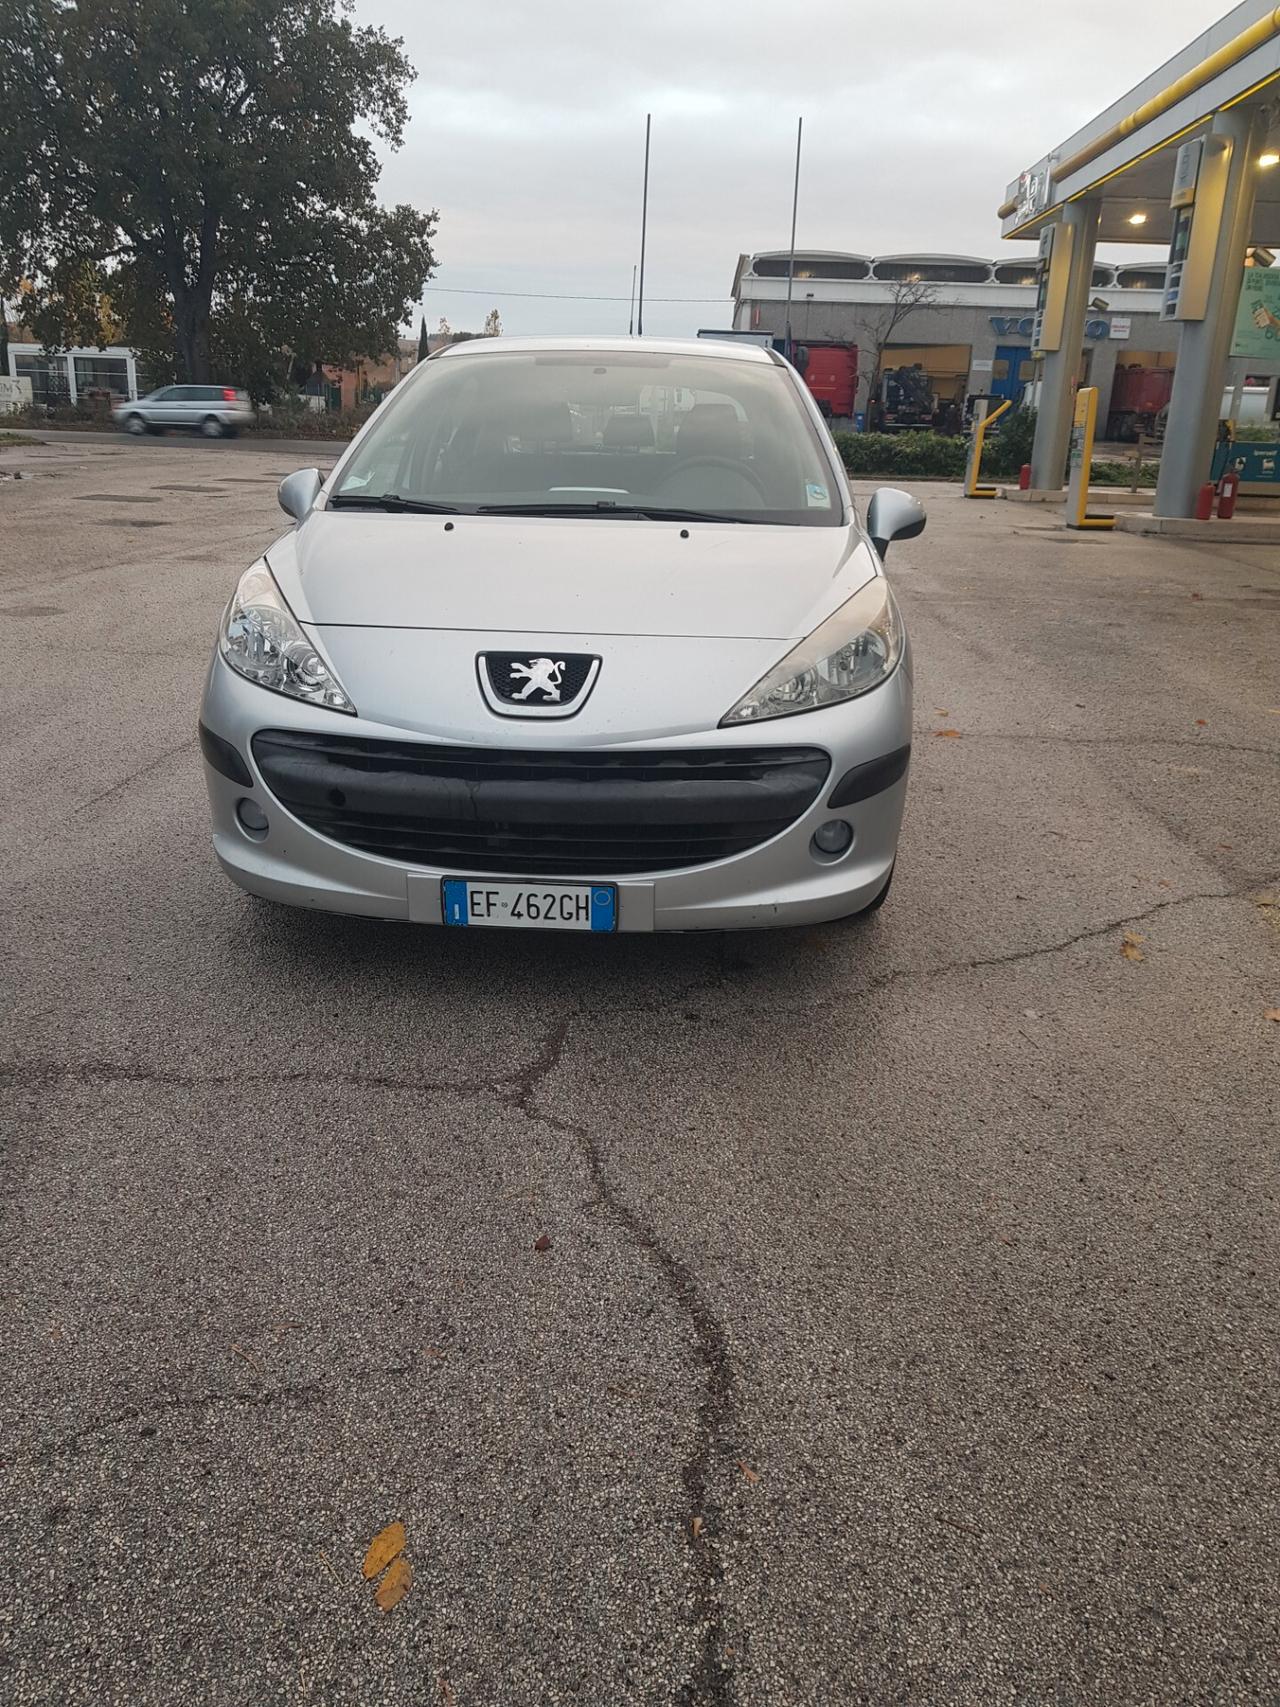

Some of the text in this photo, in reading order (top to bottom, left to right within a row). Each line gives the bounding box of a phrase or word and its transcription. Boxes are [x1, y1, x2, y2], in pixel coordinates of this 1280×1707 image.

[988, 315, 1110, 340] VOO
[470, 891, 589, 921] EF 462GH
